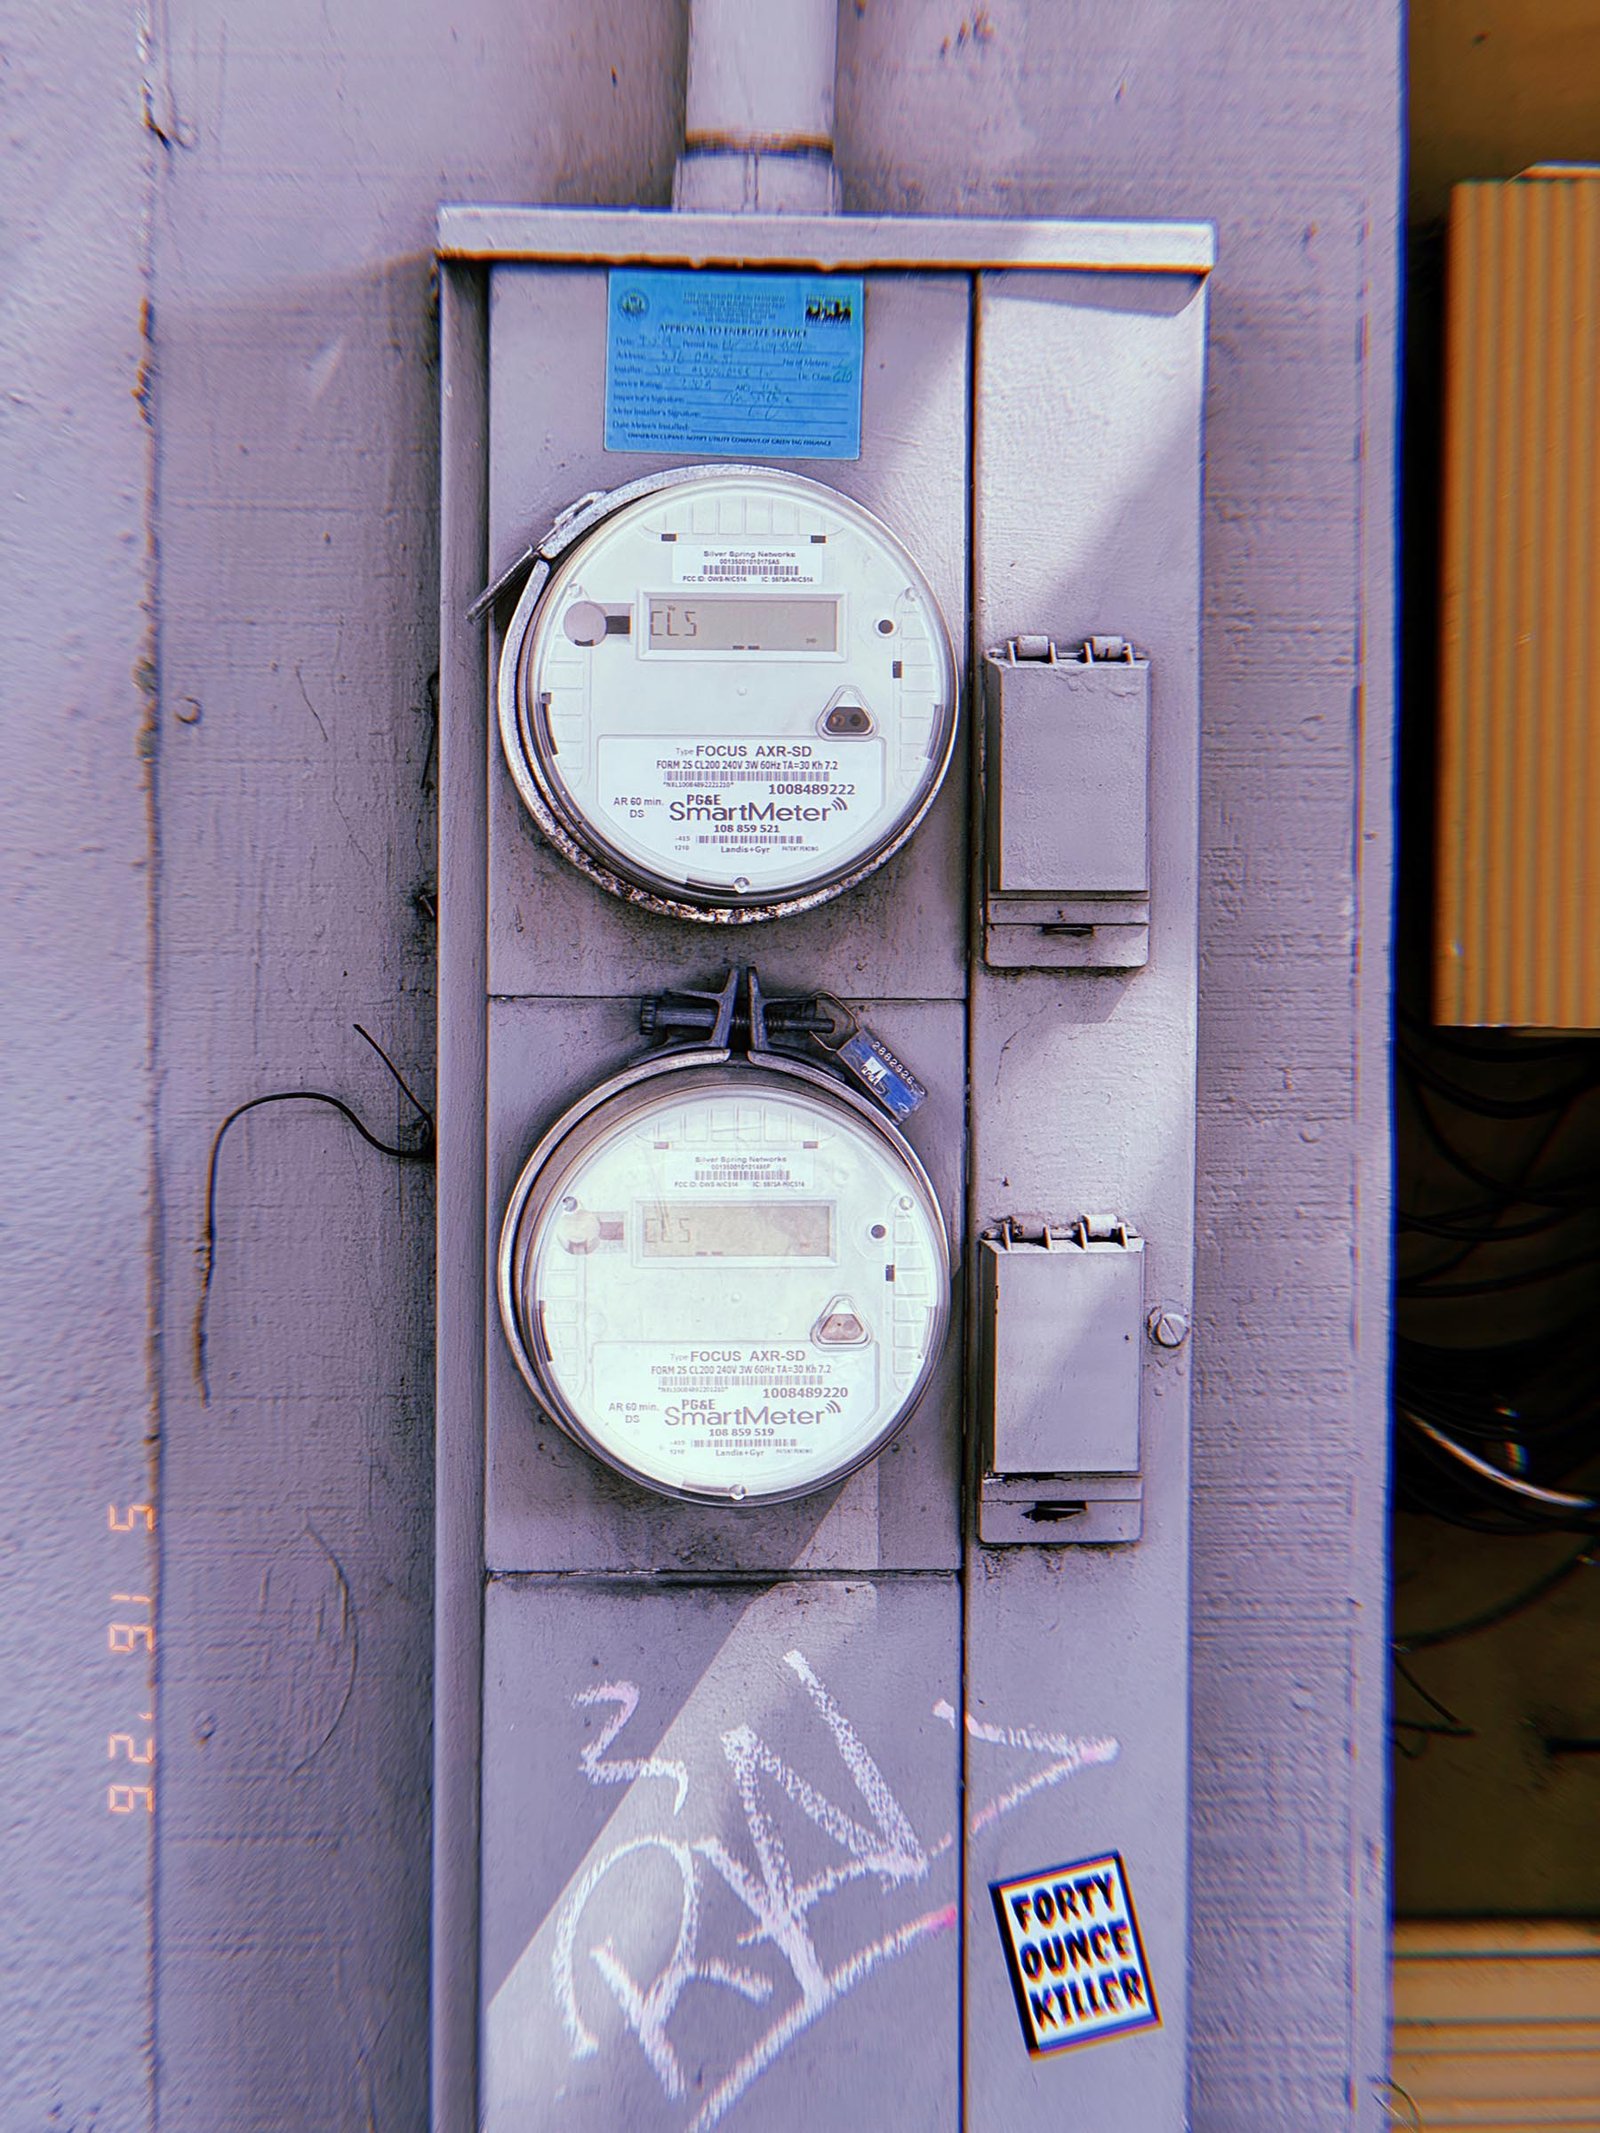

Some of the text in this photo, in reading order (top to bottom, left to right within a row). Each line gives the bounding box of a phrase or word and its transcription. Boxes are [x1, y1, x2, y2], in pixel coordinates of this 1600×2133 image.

[658, 324, 705, 335] APPROVAL
[708, 327, 722, 336] TO
[723, 327, 769, 337] ENERGIZE
[729, 551, 756, 559] Spring
[696, 745, 748, 757] FOCUS
[755, 745, 812, 758] AXR-SD
[656, 760, 839, 771] FORM 2S CL200 240V 3W 60Hz TA=30 Kh 7.2
[768, 784, 856, 796] 1008489222
[613, 797, 664, 807] AR 60 min.
[686, 794, 721, 806] PG&E
[629, 810, 645, 819] DS
[669, 801, 832, 822] SmartMeter
[714, 824, 780, 834] 108 859 521
[720, 846, 770, 855] Landis+Gyr
[720, 1156, 748, 1164] Spring
[690, 1350, 742, 1362] FOCUS
[749, 1350, 806, 1362] AXR-SD
[651, 1365, 832, 1375] FORM 2S CL200 240V 3W 60Hz TA=30 Kh 7.2
[762, 1387, 849, 1399] 1008489220
[608, 1402, 660, 1412] AR 60 min.
[681, 1399, 716, 1411] PG&E
[624, 1415, 640, 1424] DS
[663, 1406, 825, 1426] SmartMeter
[709, 1428, 775, 1437] 108 859 519
[715, 1449, 765, 1458] Landis+Gyr
[1010, 1871, 1116, 1934] FORTY
[1019, 1919, 1131, 1984] OUNCE
[1028, 1965, 1146, 2033] KILLER
